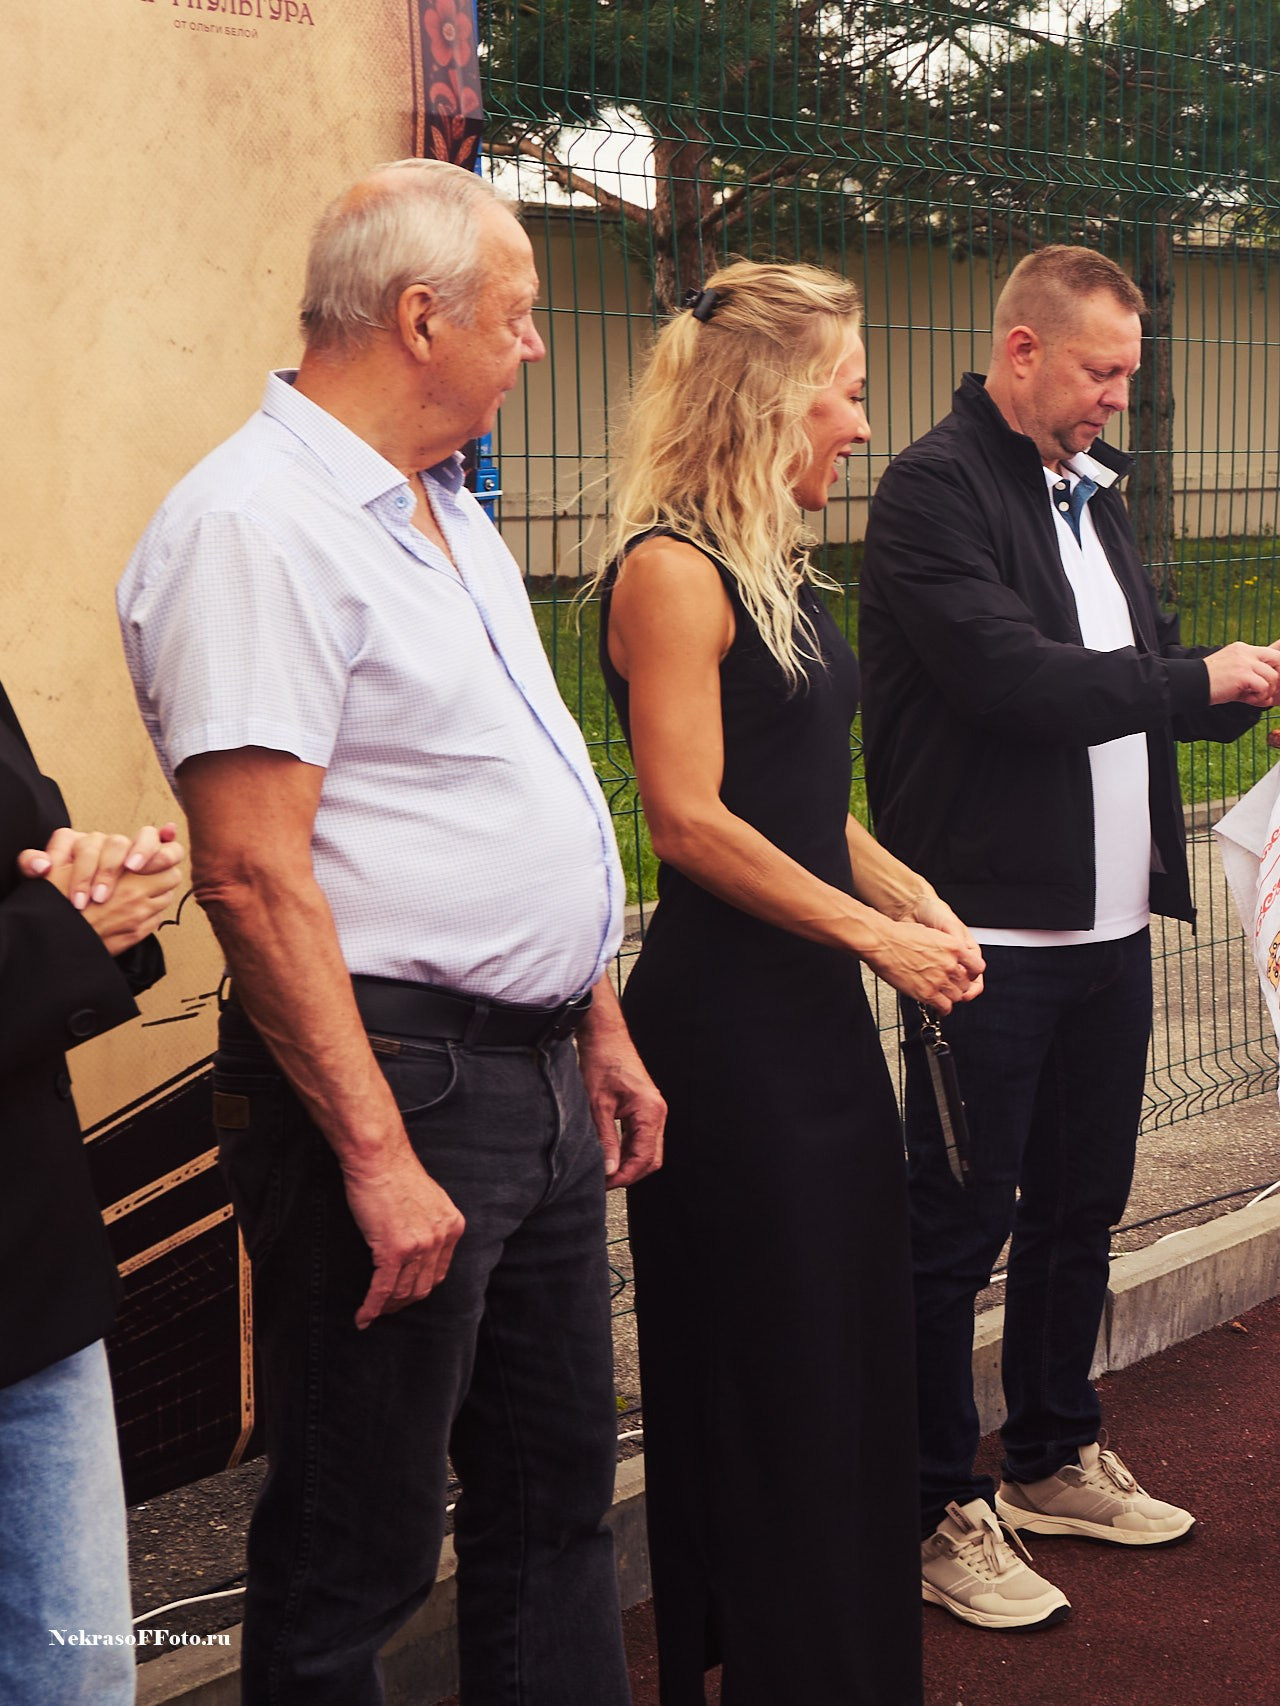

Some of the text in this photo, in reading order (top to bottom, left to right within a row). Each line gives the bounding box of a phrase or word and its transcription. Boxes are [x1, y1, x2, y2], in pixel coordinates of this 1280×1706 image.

[174, 19, 259, 39] ОТ ОЛЬГИ БЕЛОЙ
